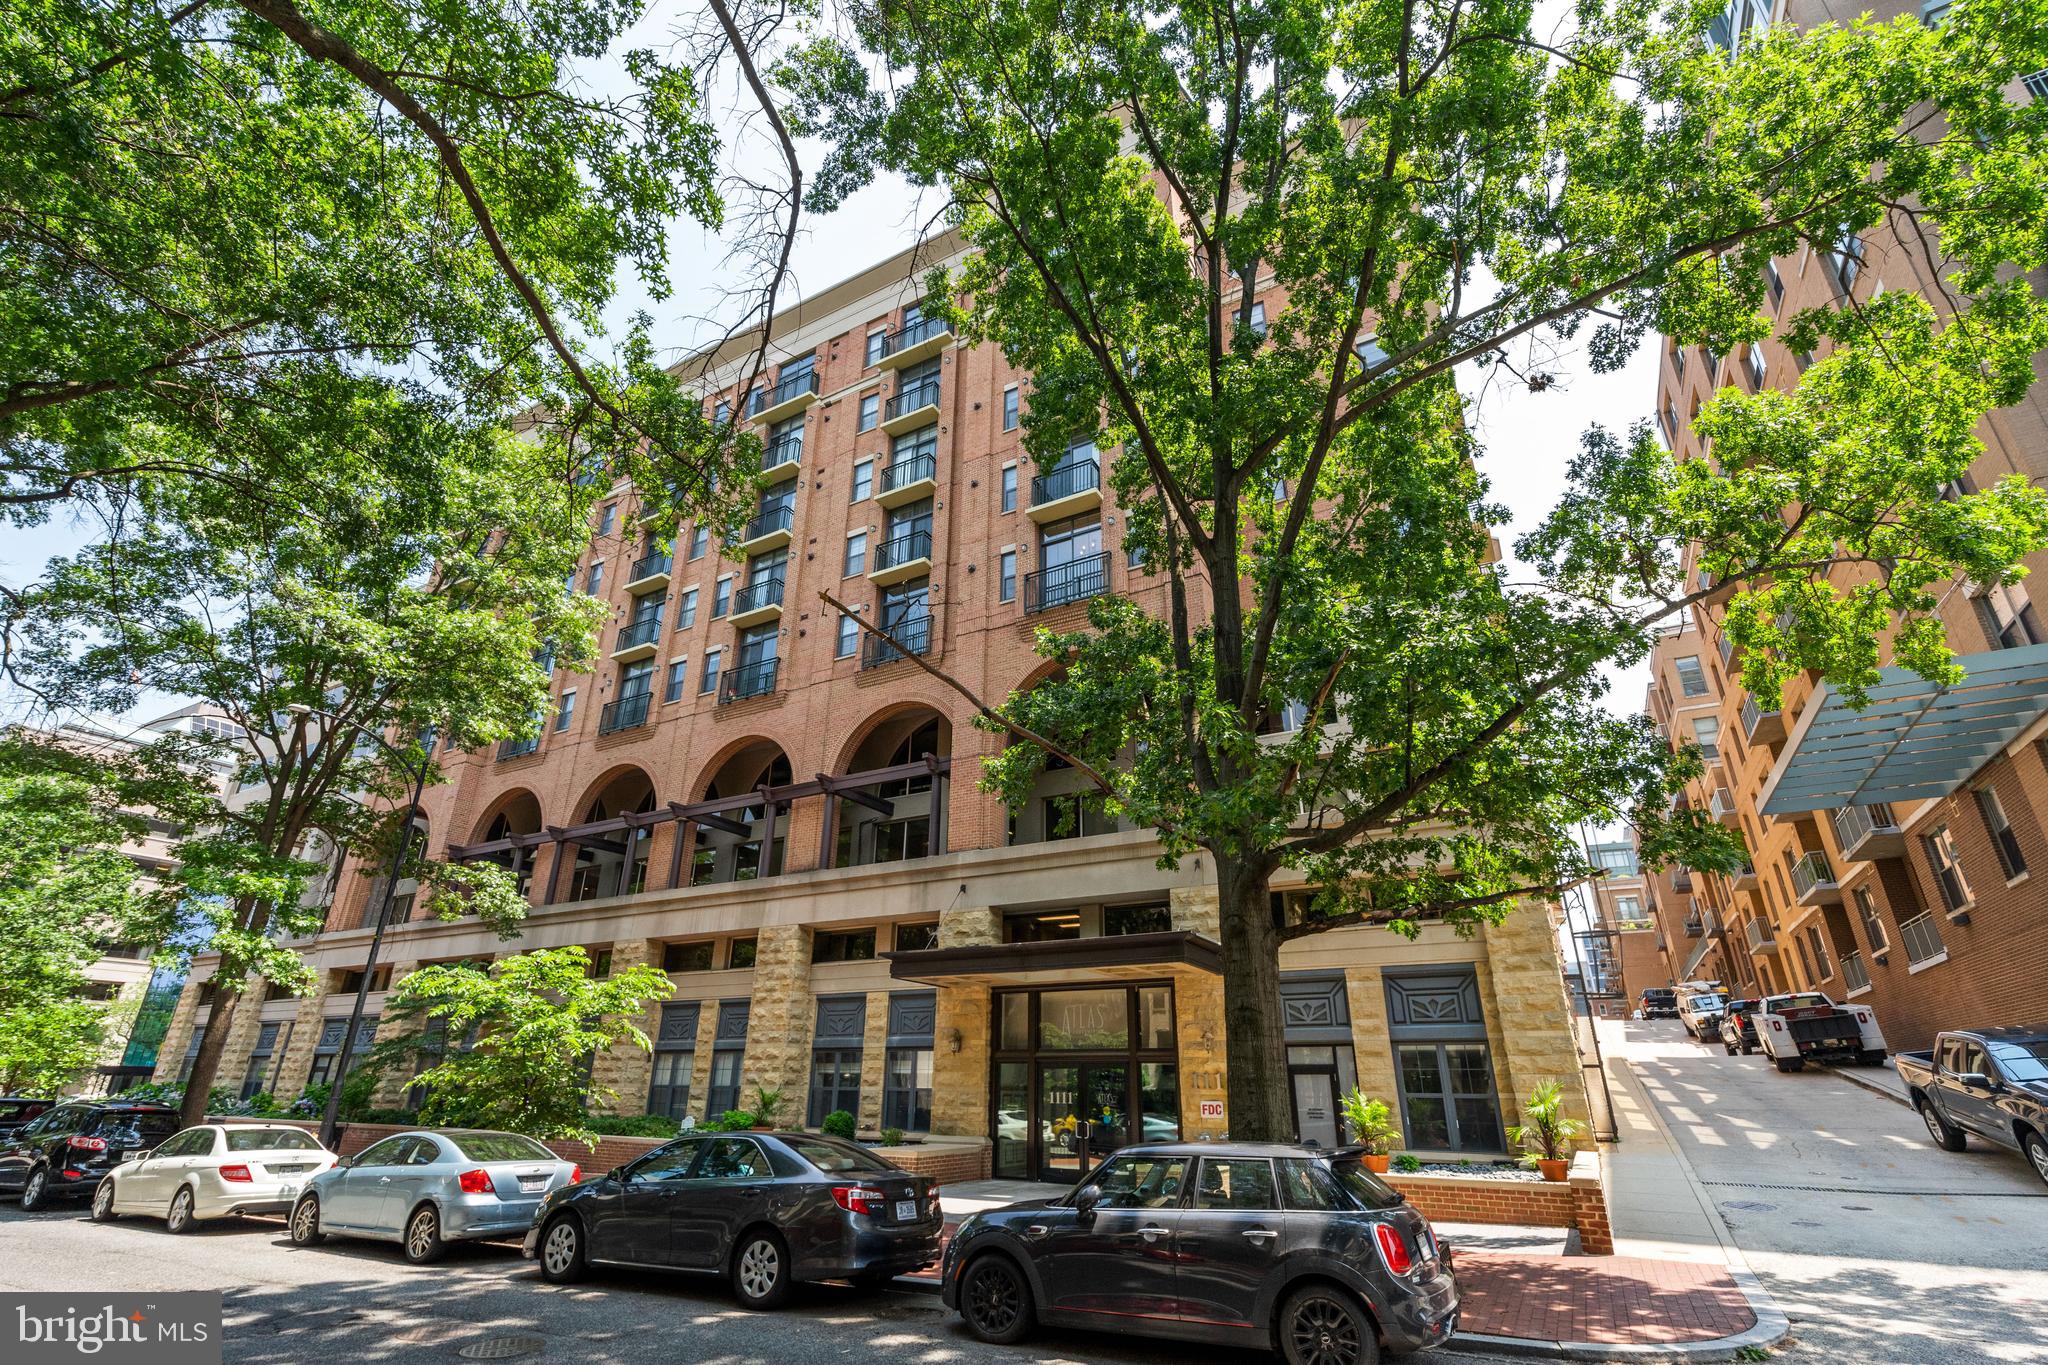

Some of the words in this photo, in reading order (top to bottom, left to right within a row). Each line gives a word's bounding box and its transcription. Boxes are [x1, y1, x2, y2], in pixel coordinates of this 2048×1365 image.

[1062, 1003, 1104, 1040] ATLAS
[1050, 1091, 1072, 1104] 1111
[1202, 1104, 1222, 1115] FDC
